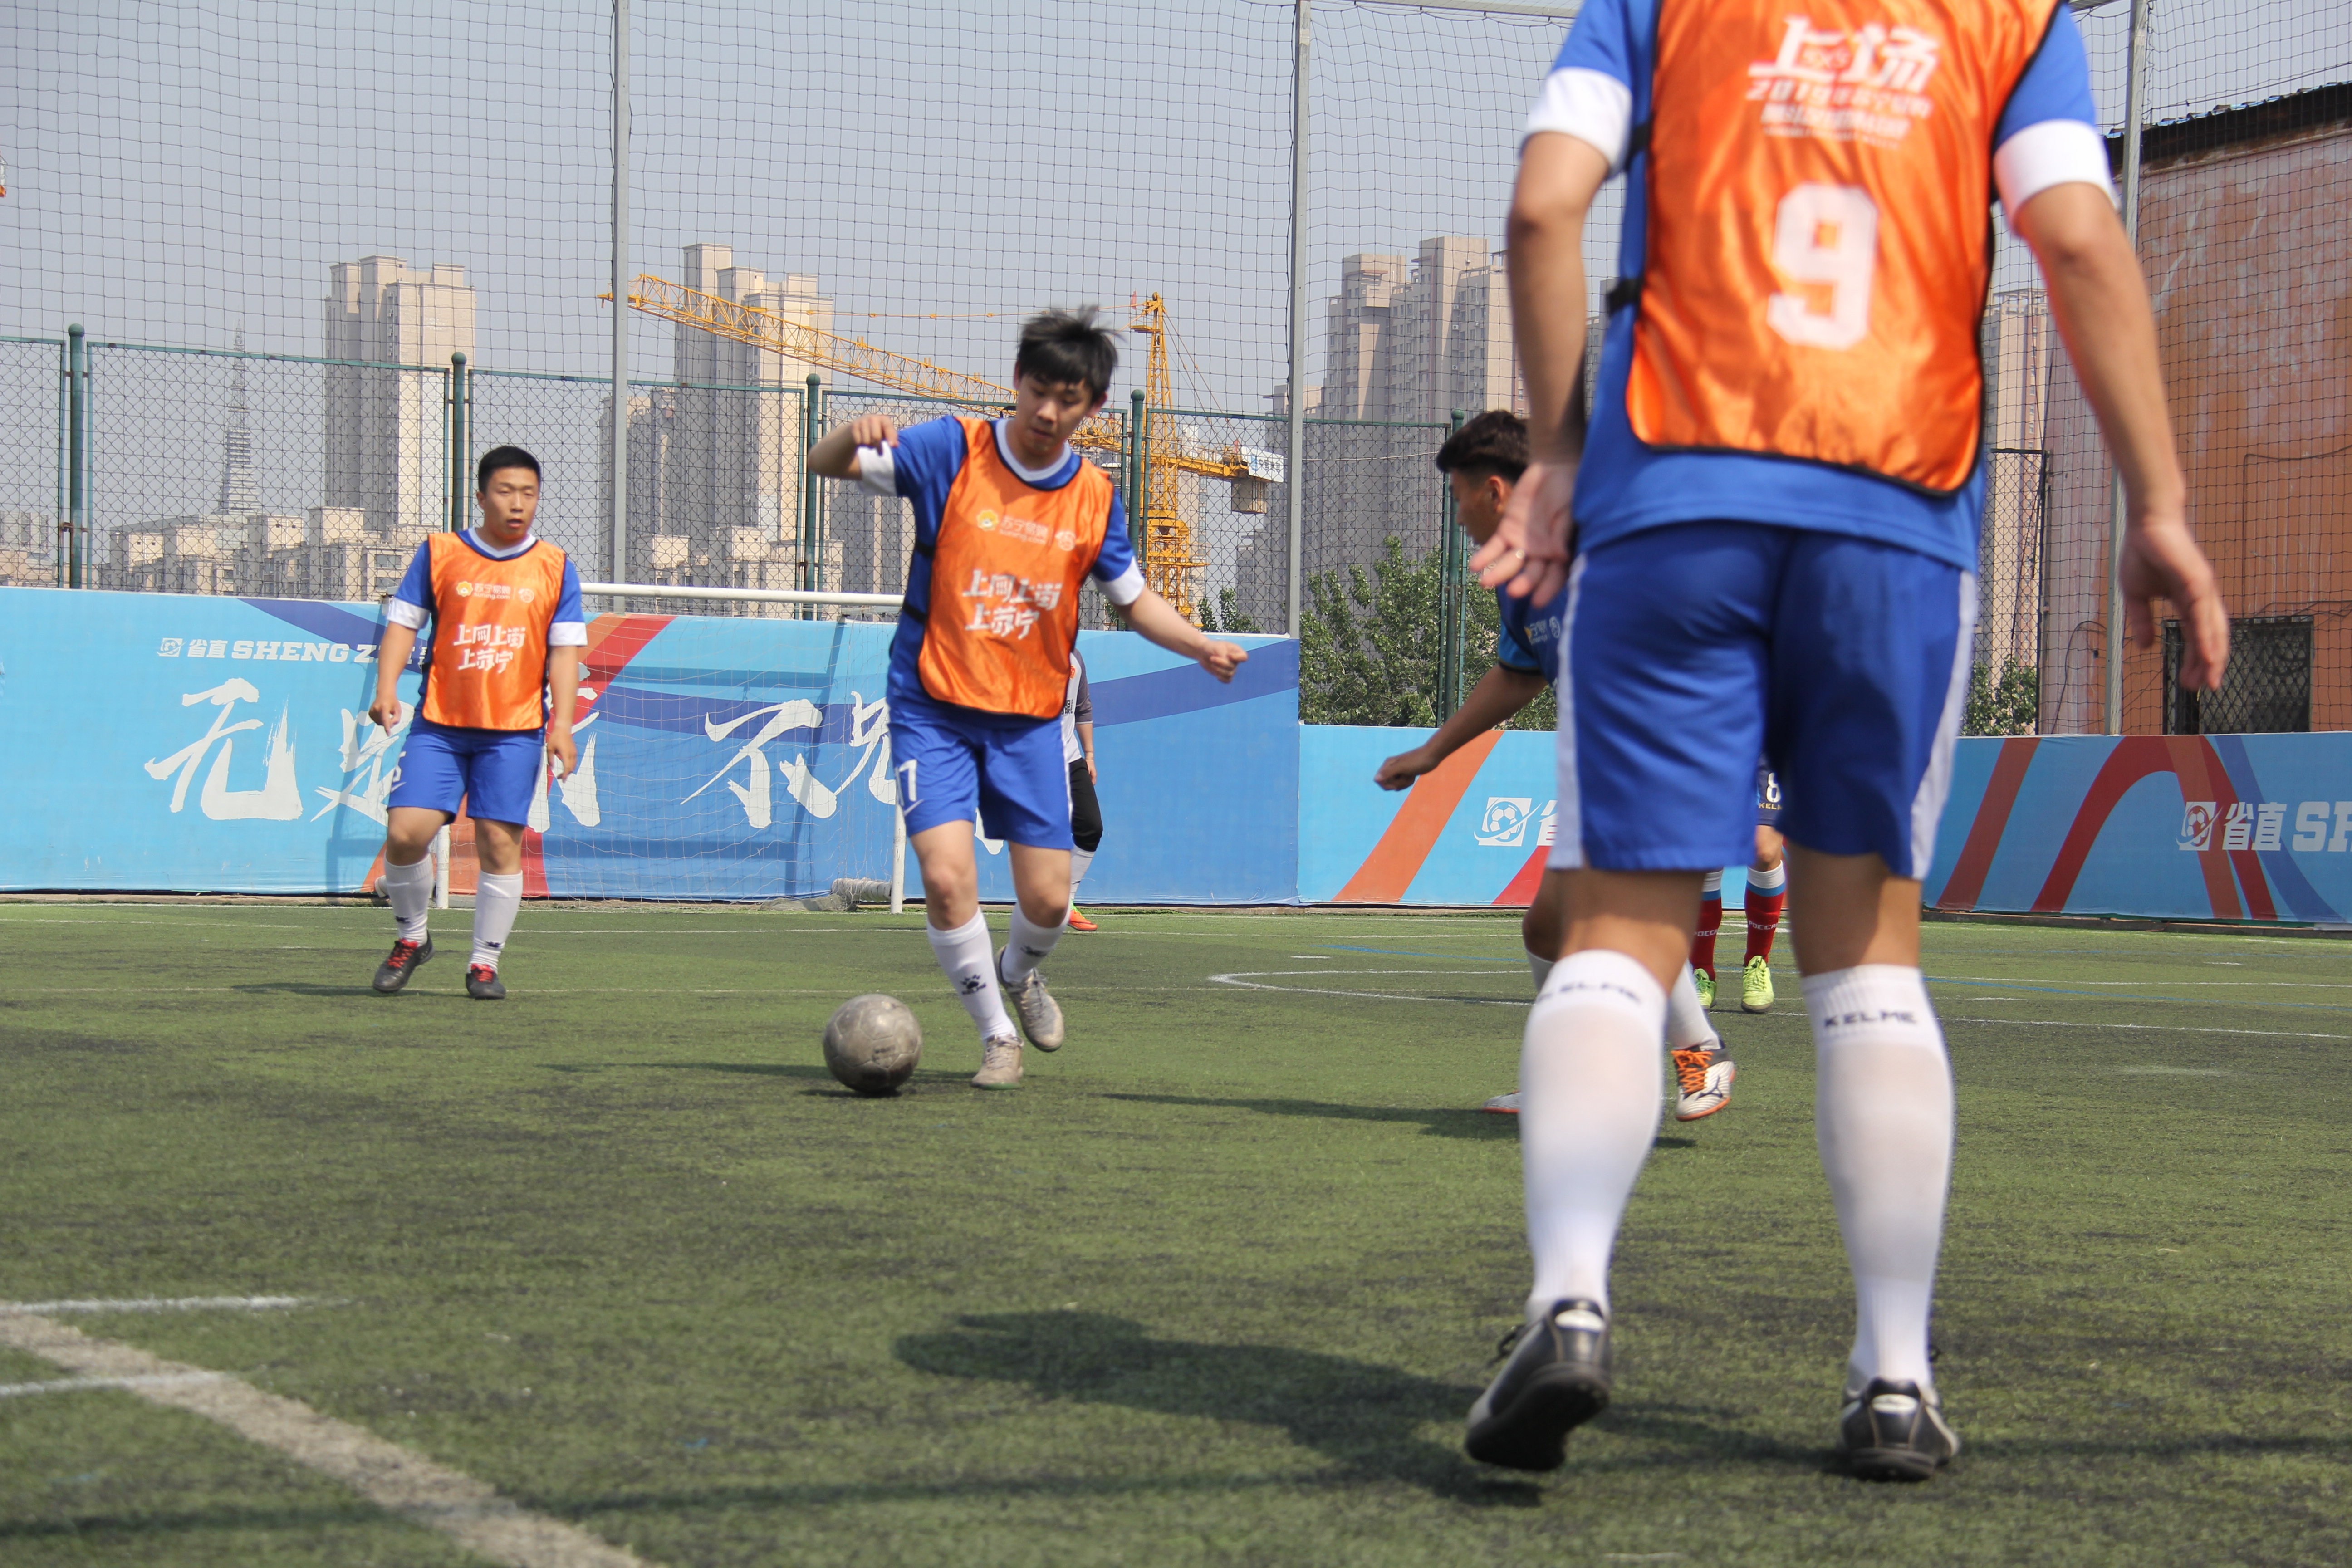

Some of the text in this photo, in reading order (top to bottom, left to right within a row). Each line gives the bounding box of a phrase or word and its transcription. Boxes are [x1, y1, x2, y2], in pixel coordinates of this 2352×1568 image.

[1767, 183, 1879, 351] 9
[474, 583, 511, 595] 苏宁易购
[965, 602, 1040, 640] 上苏宁
[187, 639, 228, 658] 省直
[231, 640, 349, 663] SHENG
[458, 648, 514, 674] 上苏宁
[2222, 802, 2287, 851] 省直
[1824, 1010, 1917, 1028] KELME
